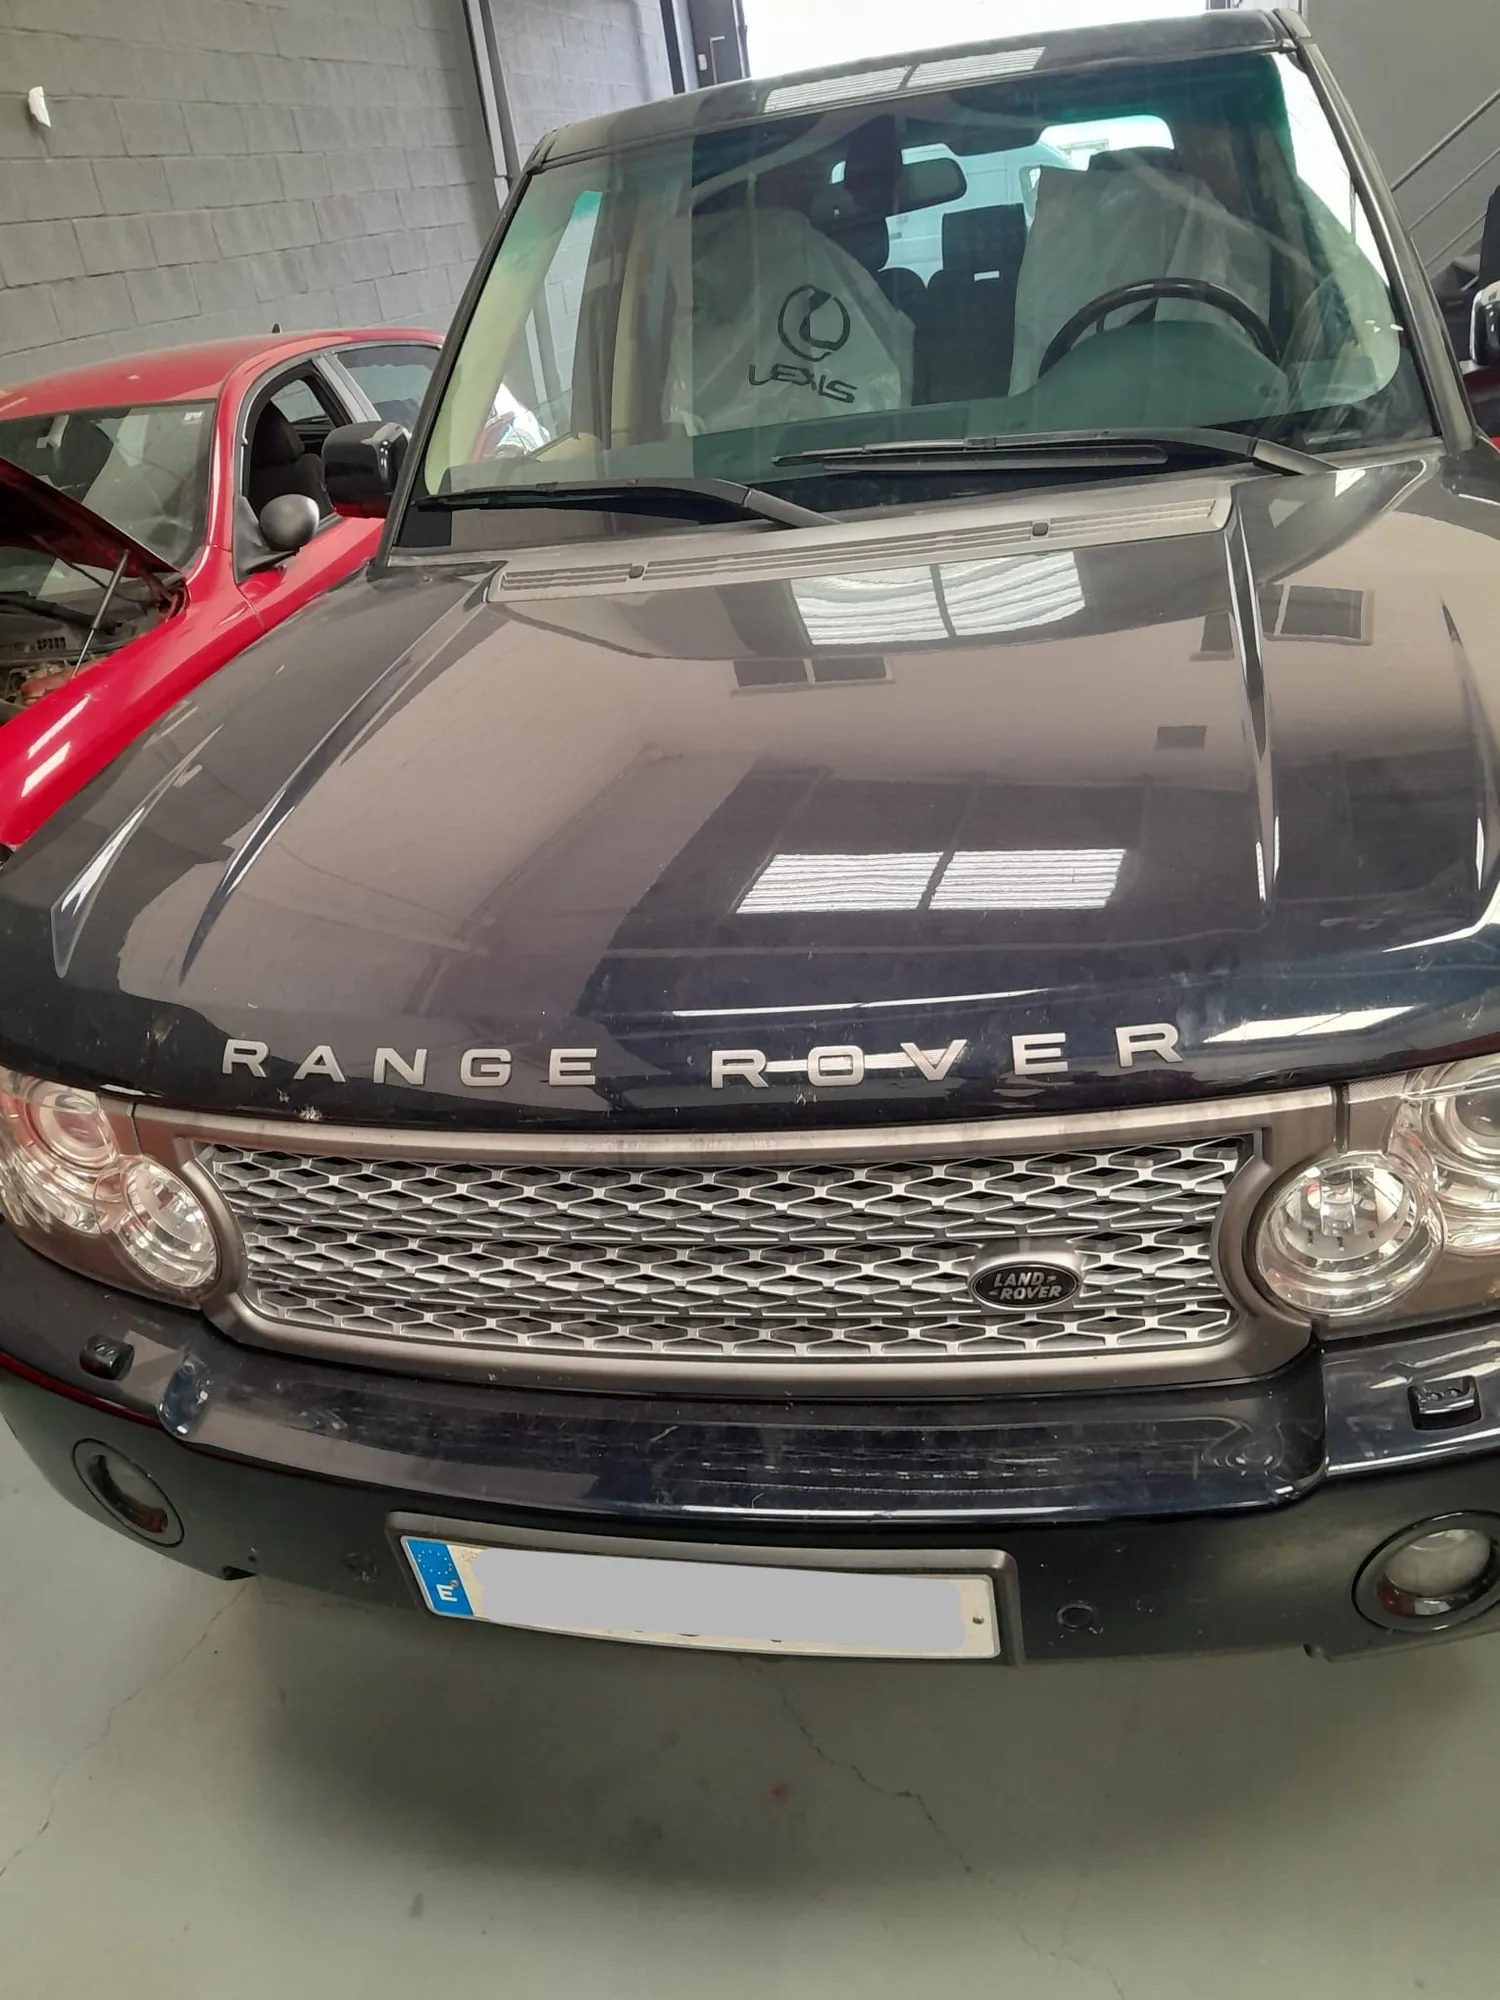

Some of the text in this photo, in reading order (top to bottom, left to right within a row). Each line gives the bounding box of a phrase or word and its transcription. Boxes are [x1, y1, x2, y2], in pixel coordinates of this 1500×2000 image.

[221, 1022, 1184, 1089] RANGE ROVER
[436, 1583, 457, 1602] E
